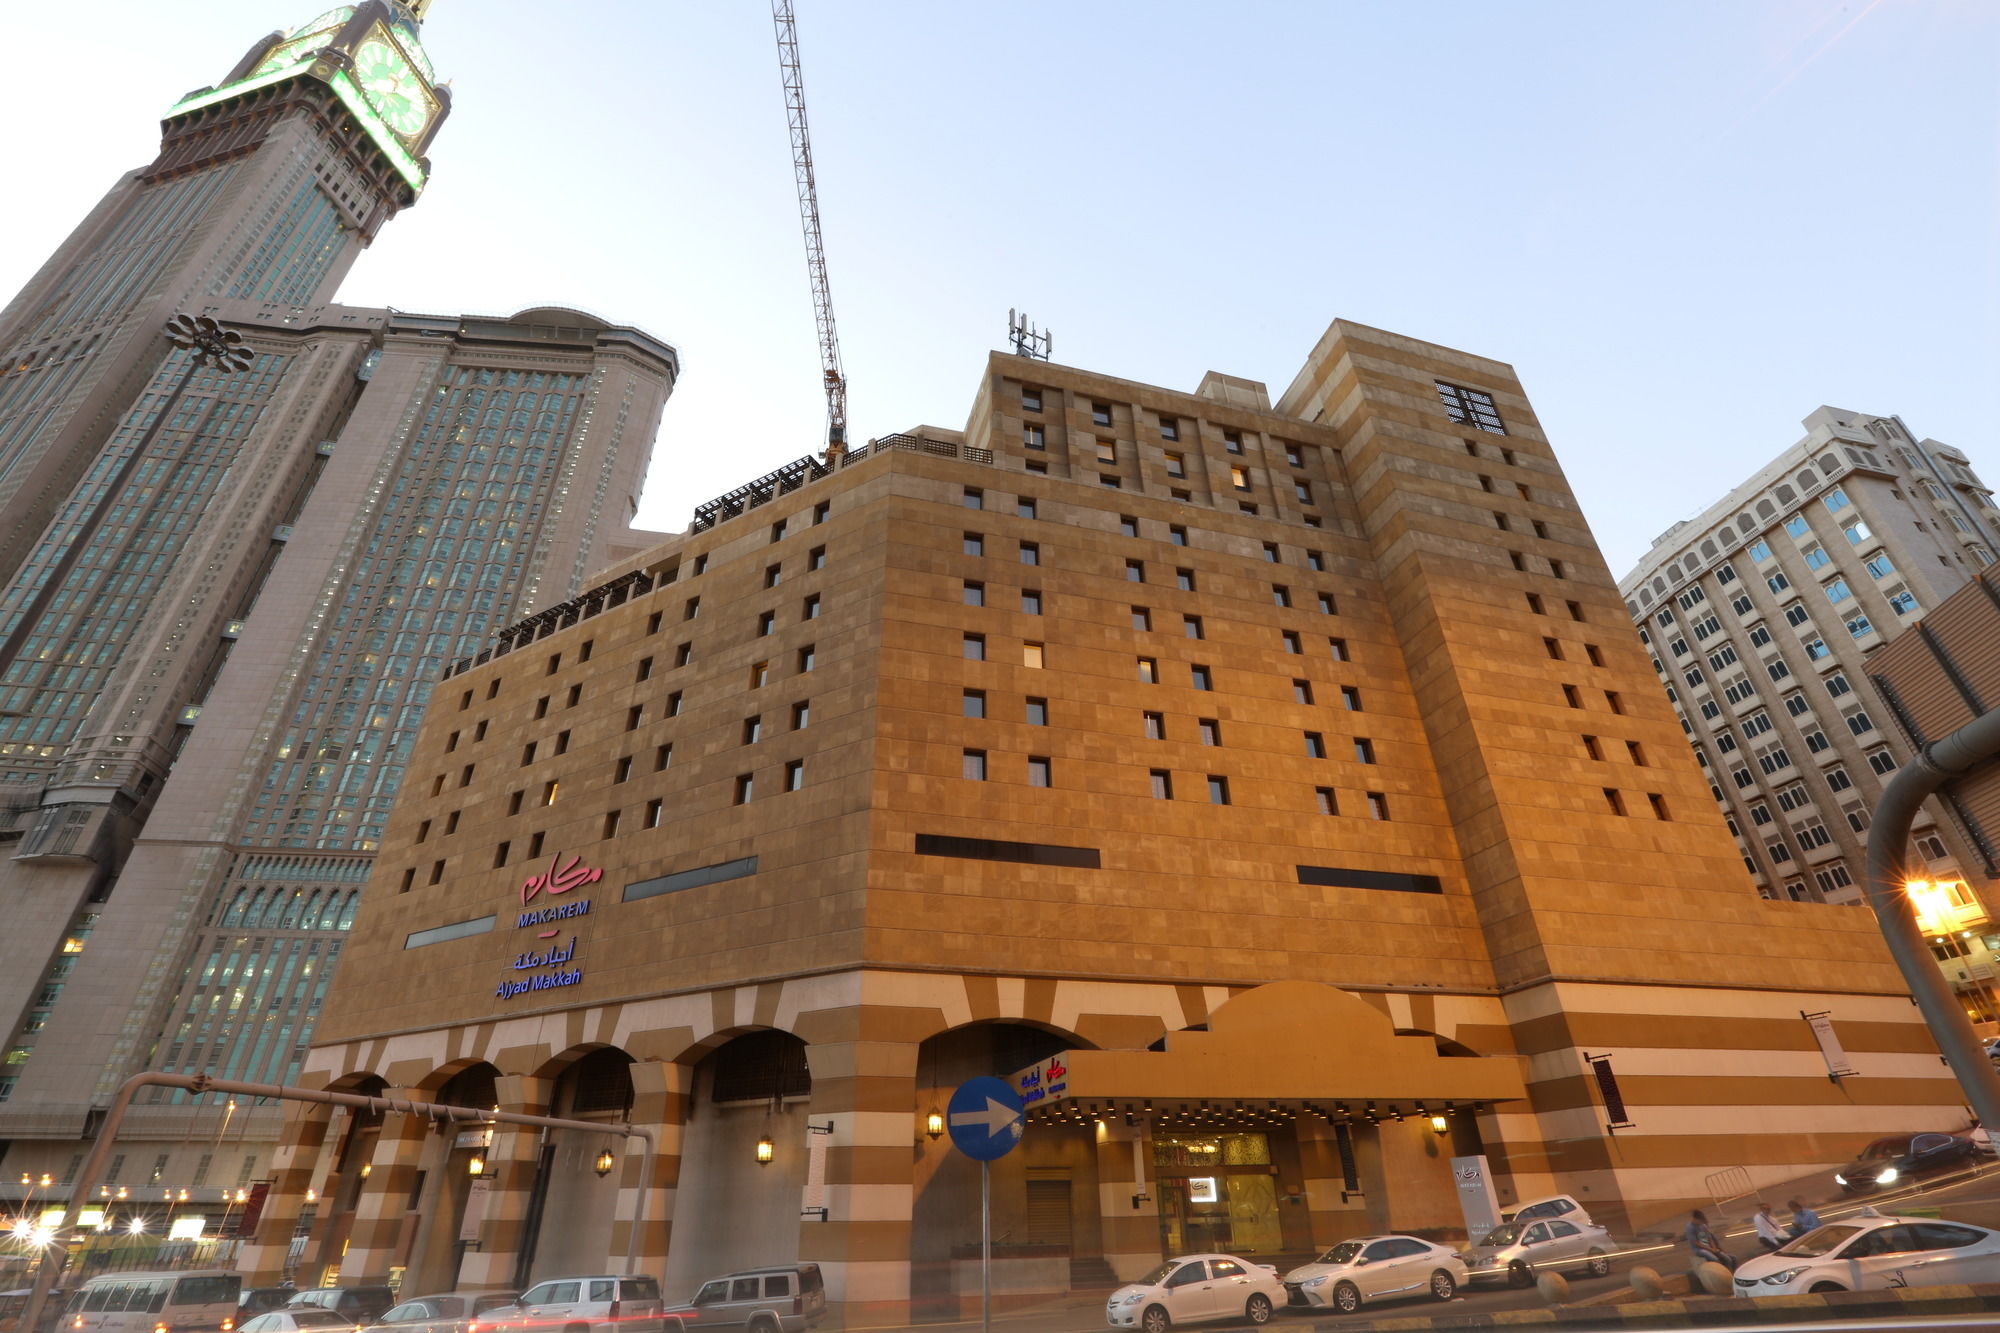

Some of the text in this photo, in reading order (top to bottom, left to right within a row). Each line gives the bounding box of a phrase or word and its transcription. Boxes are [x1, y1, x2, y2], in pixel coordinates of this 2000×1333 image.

[517, 899, 591, 929] MAKAREM
[513, 936, 577, 971] أجياد مكة
[496, 968, 582, 1000] Ajyad Makkah
